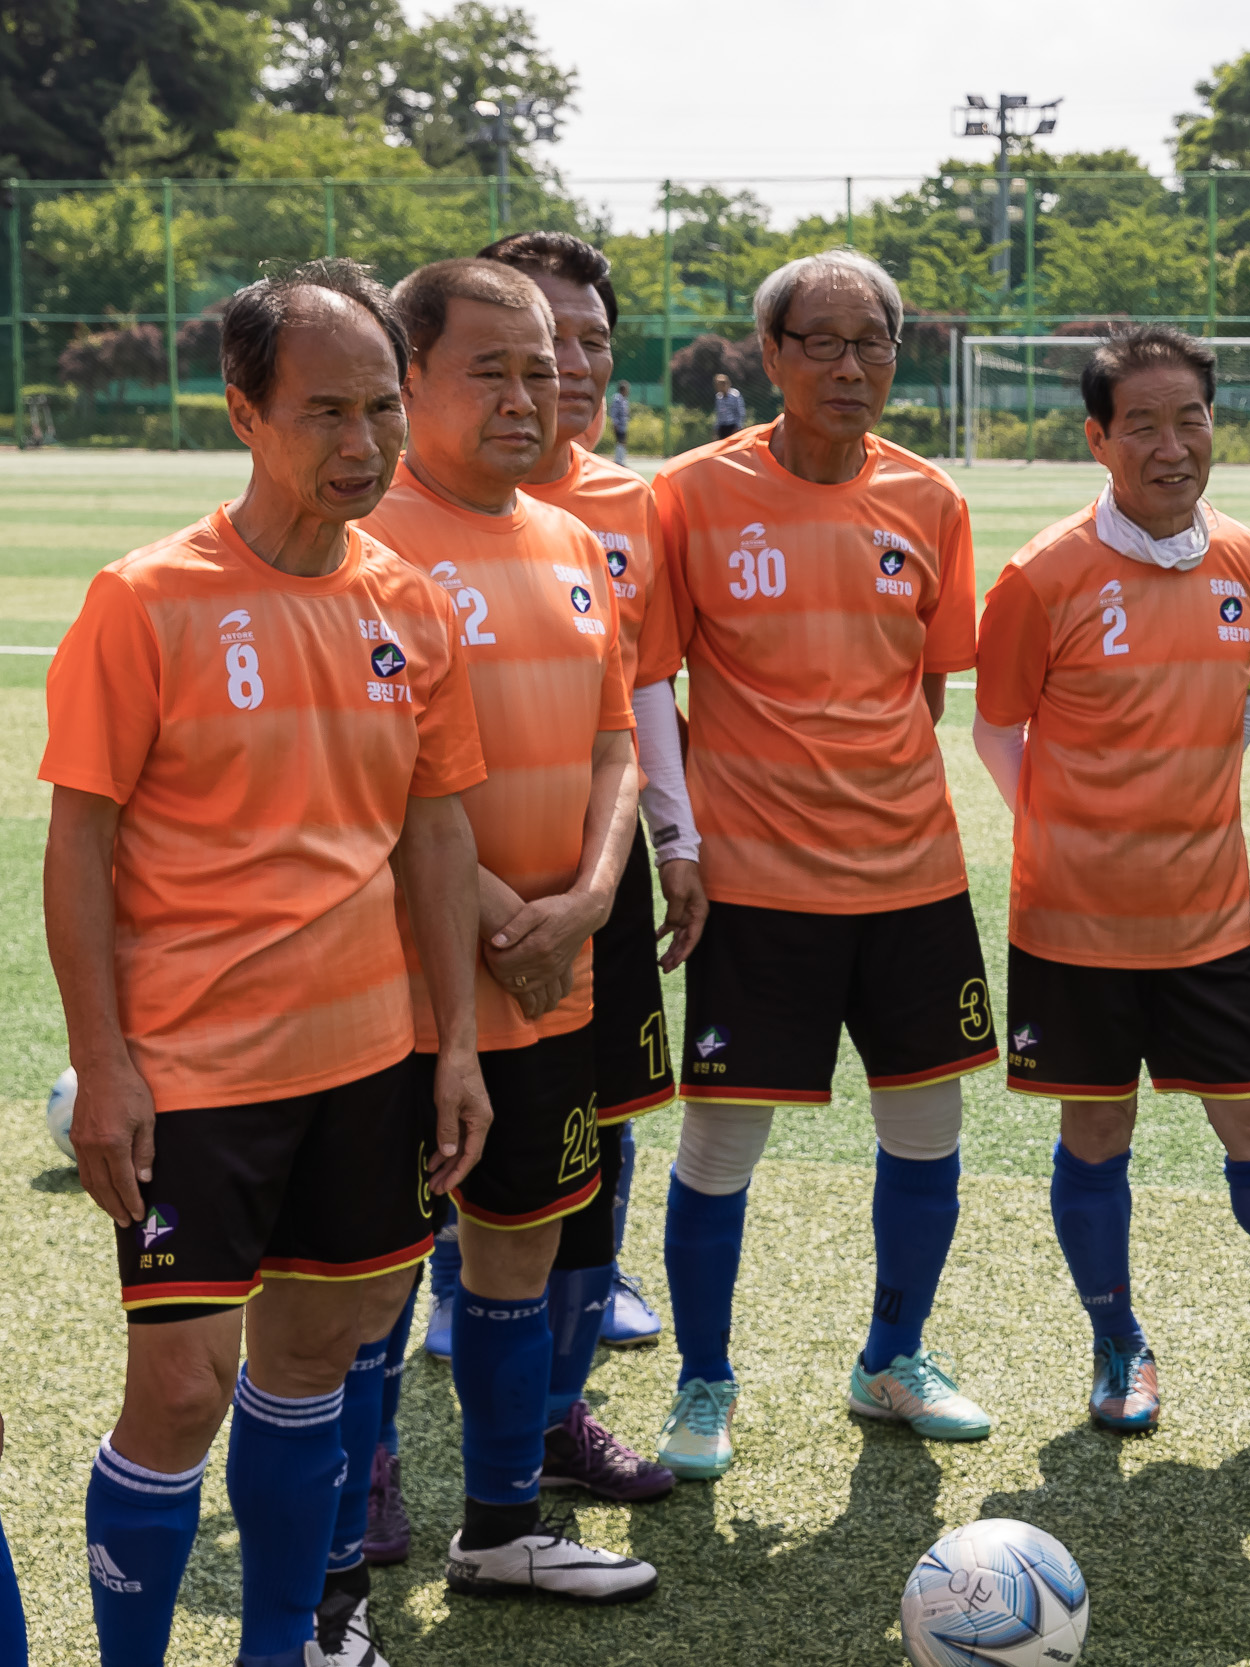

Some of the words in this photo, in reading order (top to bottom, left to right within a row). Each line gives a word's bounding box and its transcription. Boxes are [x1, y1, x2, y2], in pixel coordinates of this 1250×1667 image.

[873, 529, 915, 553] SEOUL
[728, 548, 786, 600] 30
[1210, 578, 1248, 598] SEOUL
[220, 630, 254, 641] ASTORE
[358, 618, 404, 649] SEOL
[1102, 605, 1130, 656] 2
[225, 643, 264, 710] 8
[640, 1011, 673, 1080] 1
[712, 1062, 727, 1074] 70
[139, 1253, 153, 1269] 진
[156, 1253, 175, 1266] 70
